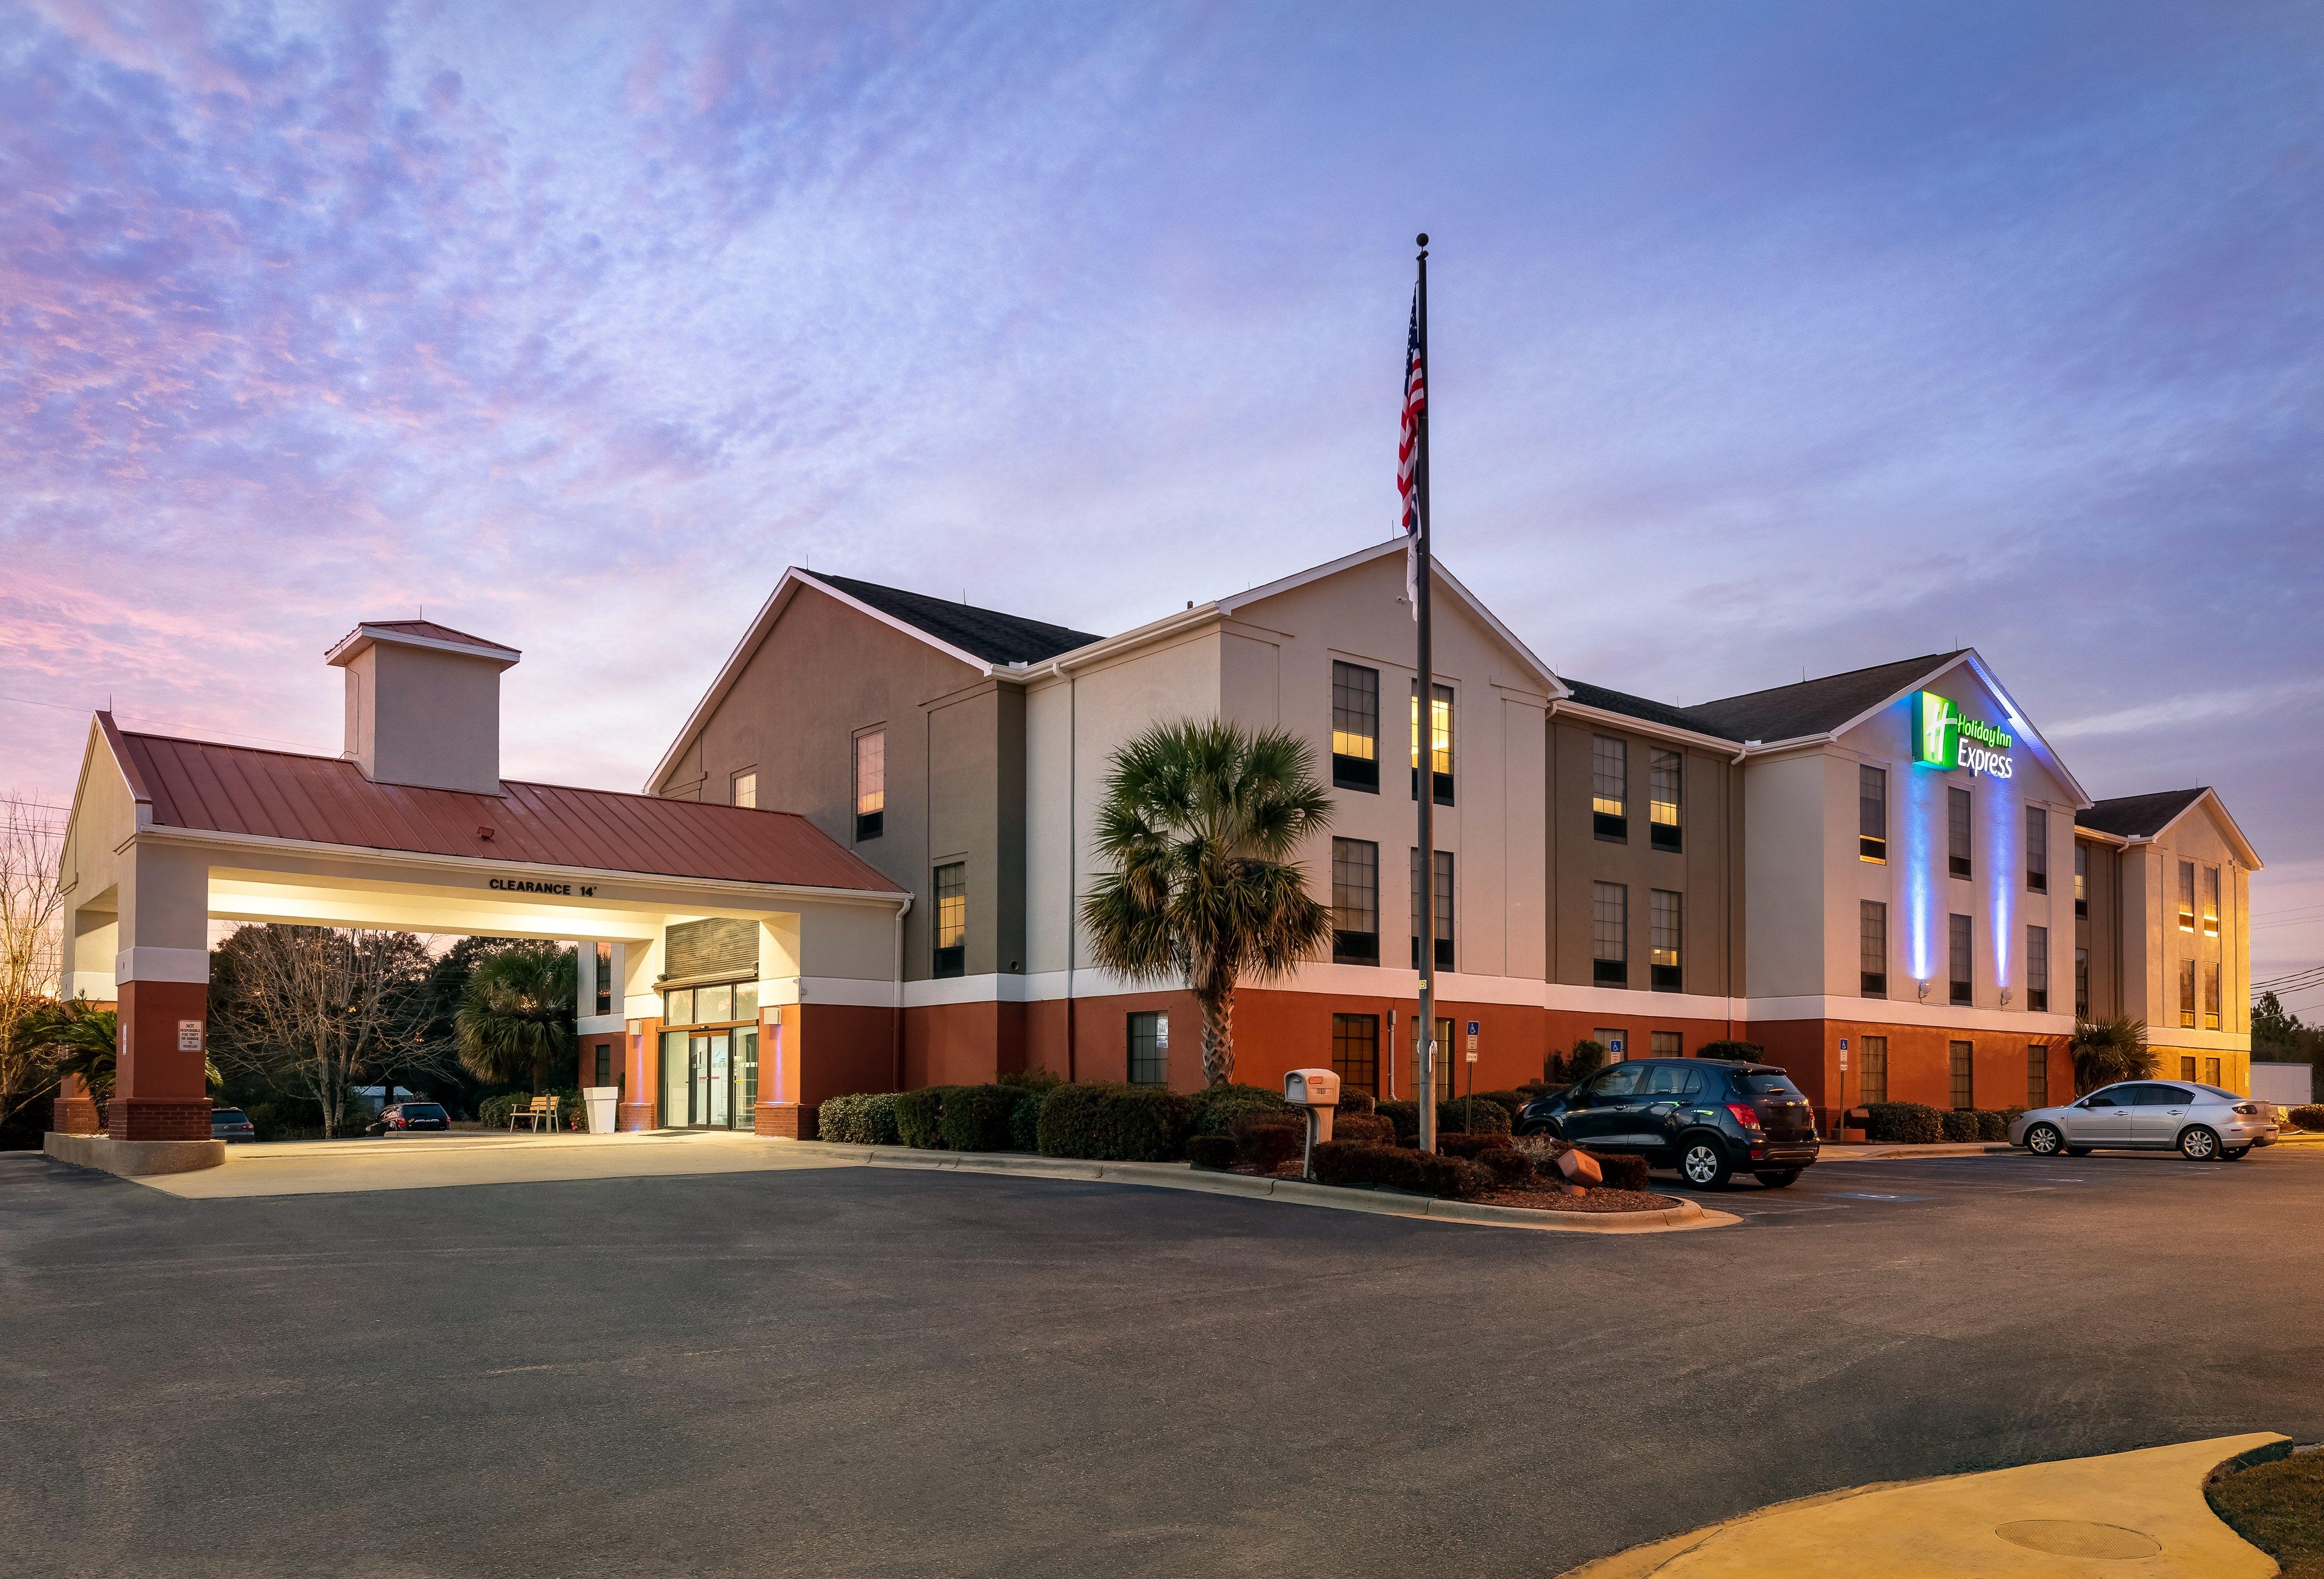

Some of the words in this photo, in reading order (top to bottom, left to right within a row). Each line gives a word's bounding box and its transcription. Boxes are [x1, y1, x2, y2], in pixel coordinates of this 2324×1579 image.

[1957, 714, 1996, 748] Holiday
[1996, 725, 2012, 749] Inn
[1957, 737, 2013, 778] Express
[489, 879, 571, 895] CLEARANCE
